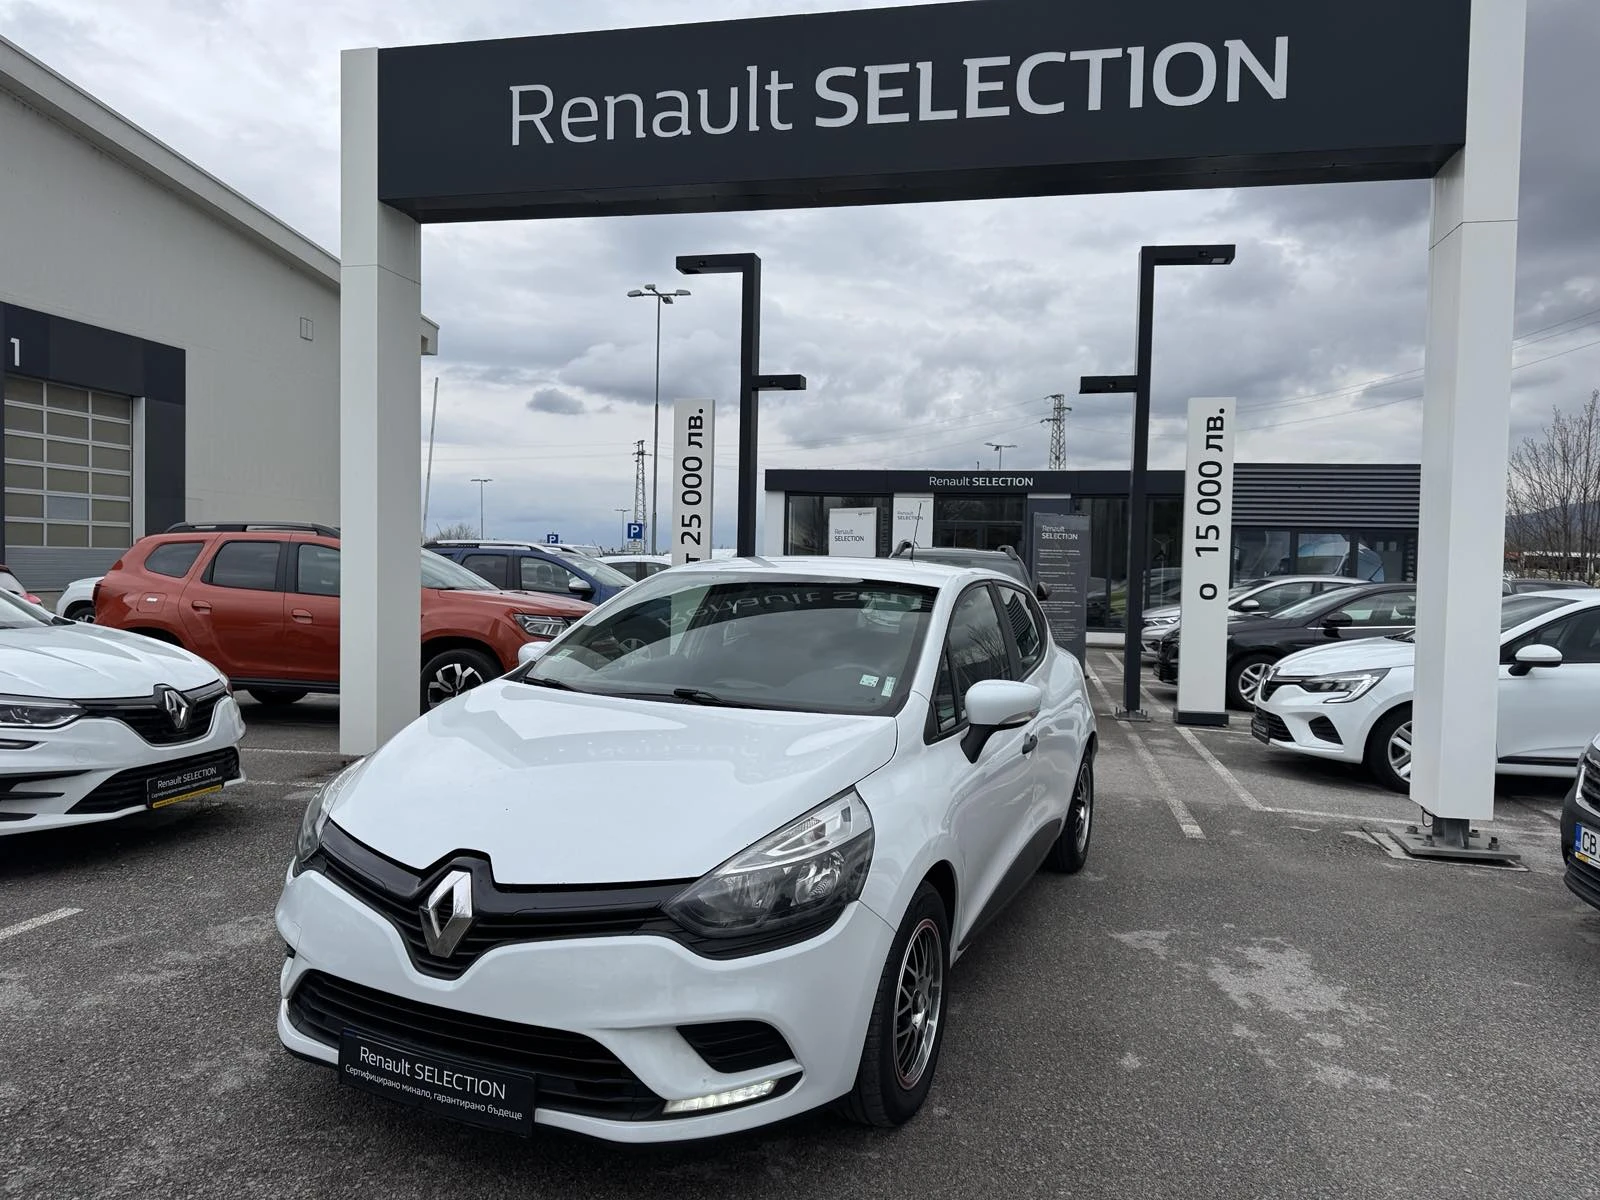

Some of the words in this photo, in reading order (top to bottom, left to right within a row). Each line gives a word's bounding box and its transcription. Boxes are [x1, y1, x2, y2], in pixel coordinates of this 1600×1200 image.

[508, 64, 795, 147] Renault
[814, 35, 1290, 129] SELECTION
[10, 337, 20, 367] 1
[688, 408, 704, 449] лв.
[1206, 407, 1225, 452] лв.
[681, 456, 703, 506] 000
[929, 476, 970, 487] Renault
[972, 477, 1034, 487] SELECTION
[1197, 460, 1223, 516] 000
[630, 525, 640, 537] P
[680, 514, 702, 545] 25
[1041, 532, 1079, 540] SELECTION
[1195, 524, 1220, 558] 15
[157, 776, 182, 789] Renault
[182, 766, 217, 783] SELECTION
[345, 1063, 401, 1090] Сертифицирано
[401, 1084, 433, 1100] минало,
[433, 1092, 486, 1112] гарантирано
[487, 1104, 523, 1120] бъдеще
[360, 1046, 411, 1077] Renault
[414, 1063, 506, 1100] SELECTION
